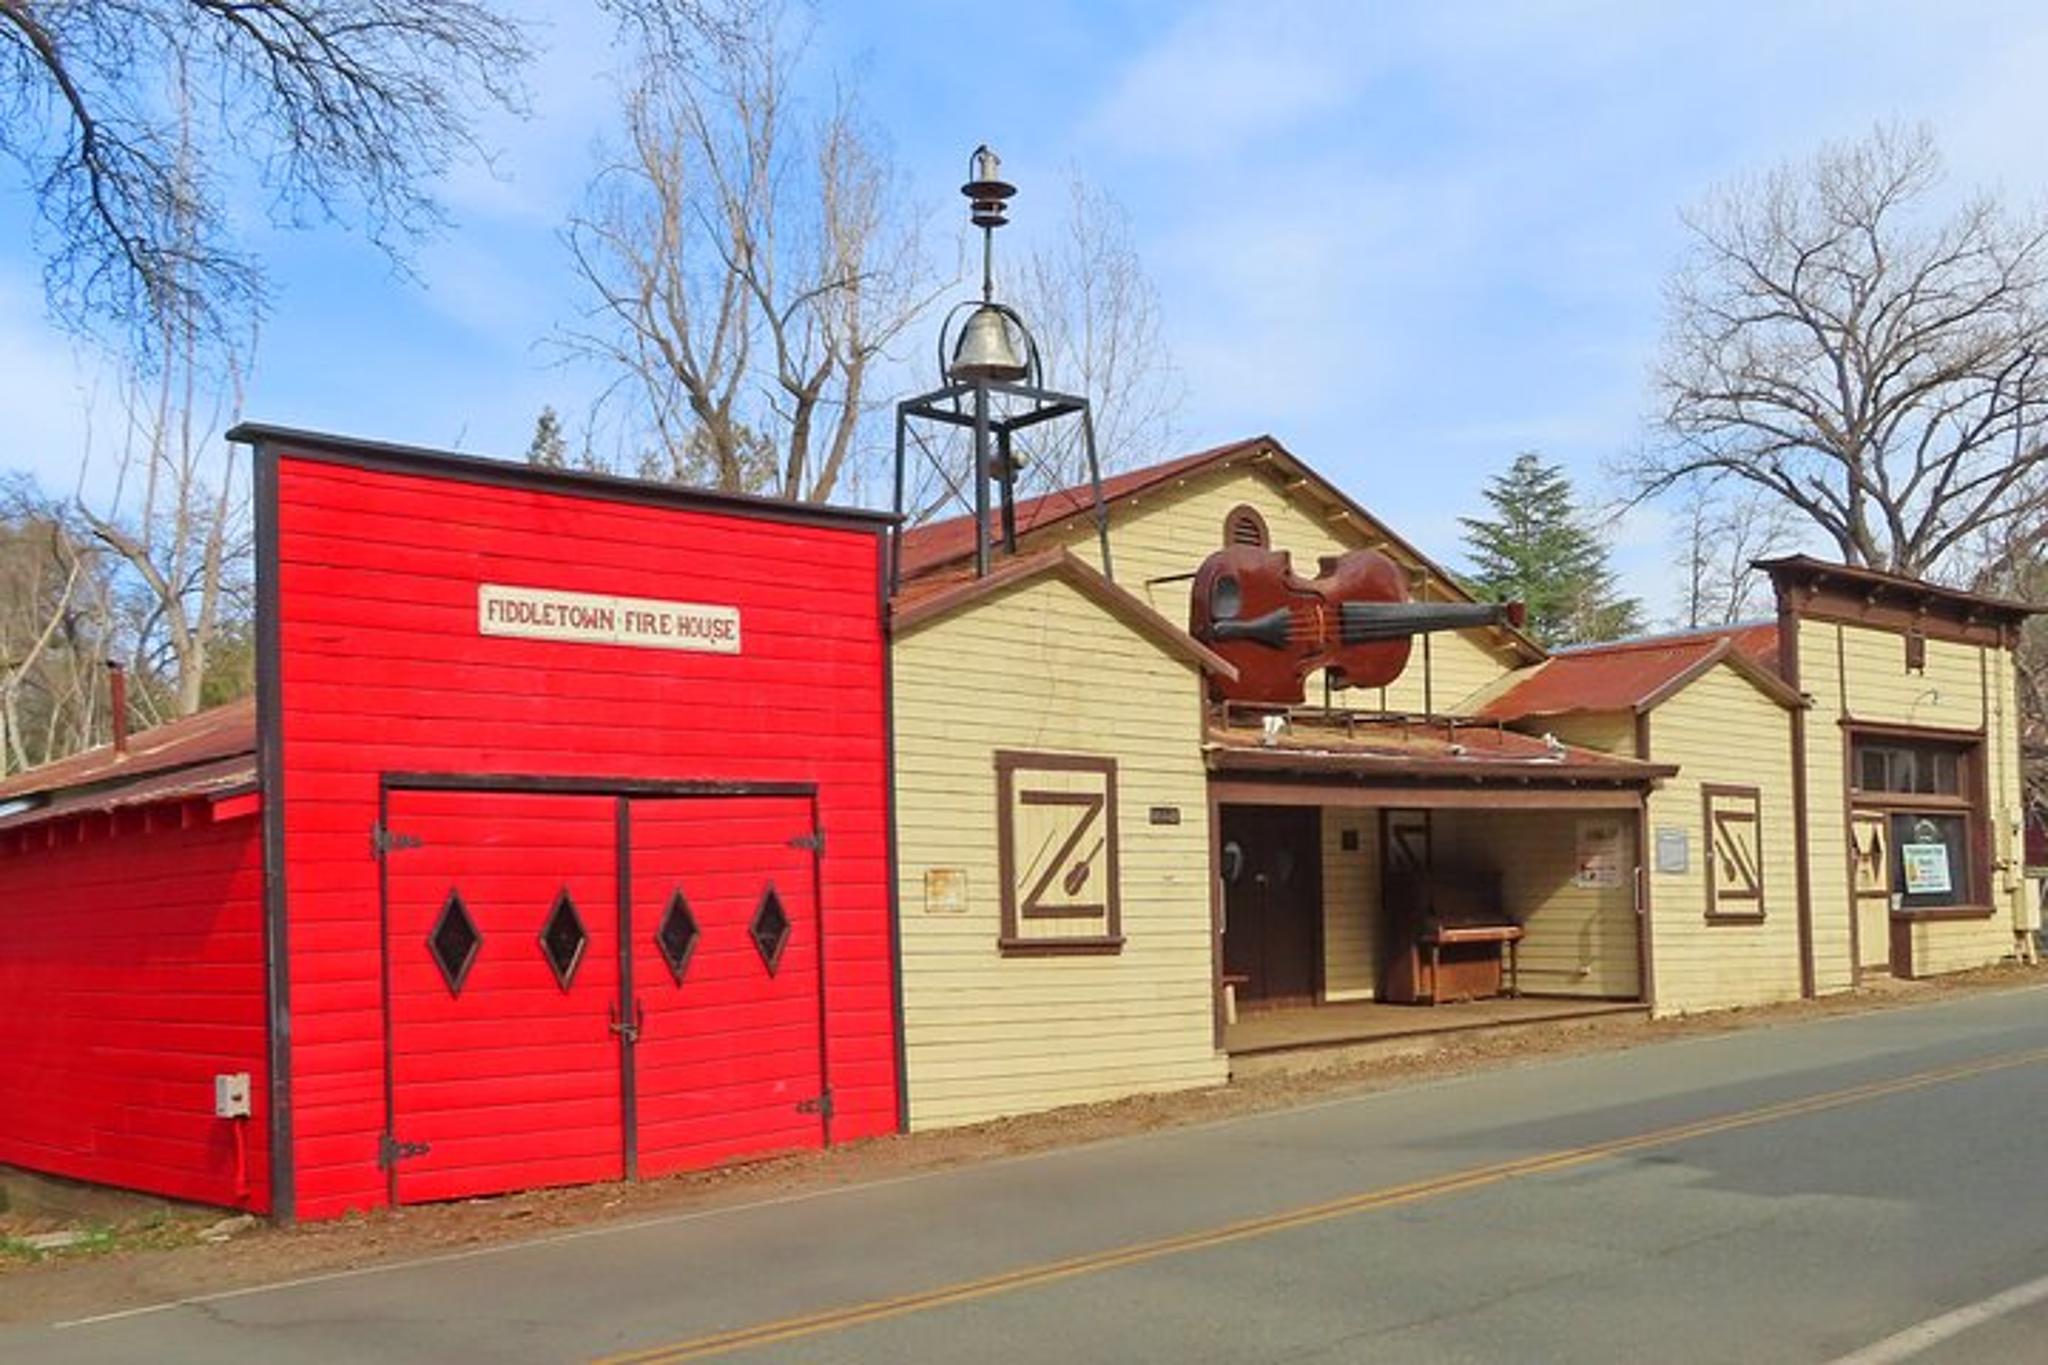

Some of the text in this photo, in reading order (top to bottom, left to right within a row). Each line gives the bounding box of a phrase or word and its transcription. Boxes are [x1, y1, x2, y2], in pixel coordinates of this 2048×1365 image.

[488, 599, 735, 640] FIDDLETOWN FIRE HOUSE
